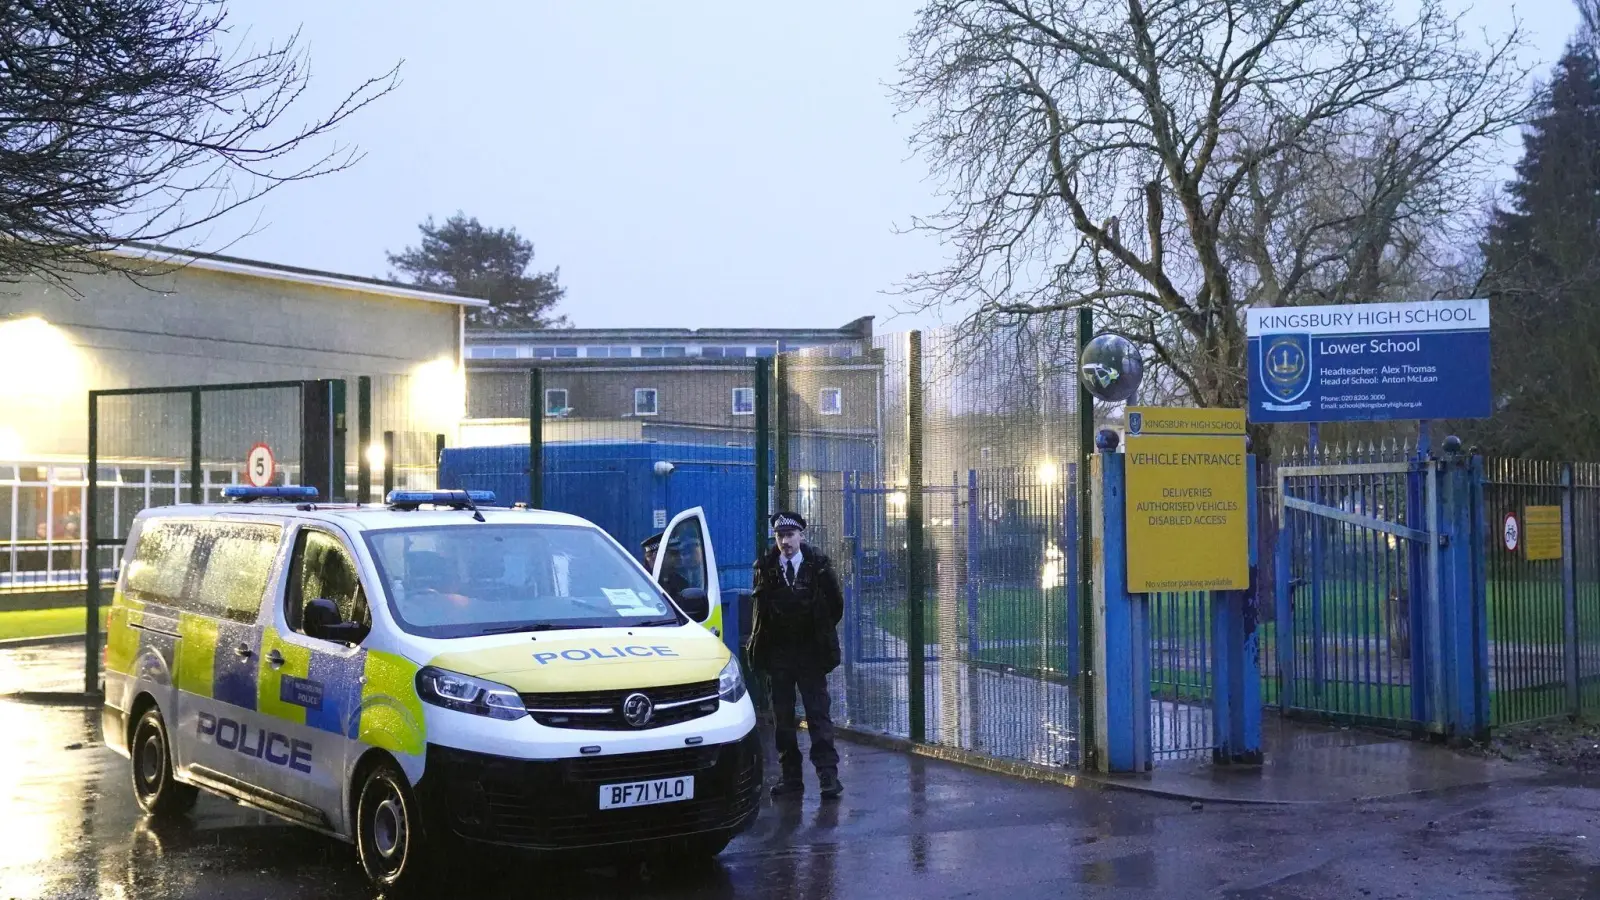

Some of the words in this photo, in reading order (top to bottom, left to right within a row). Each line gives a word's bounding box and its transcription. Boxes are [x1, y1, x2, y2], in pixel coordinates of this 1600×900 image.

[1259, 313, 1353, 329] KINGSBURY
[1358, 311, 1400, 325] HIGH
[1404, 308, 1477, 323] SCHOOL
[1320, 341, 1366, 355] Lower
[1370, 337, 1420, 353] School
[1320, 367, 1378, 376] Headteacher:
[1381, 365, 1400, 374] Alex
[1401, 364, 1437, 374] Thomas
[1342, 377, 1350, 385] of
[1351, 376, 1379, 385] School:
[1382, 375, 1406, 383] Anton
[1407, 374, 1438, 383] McLean
[1145, 420, 1189, 428] KINGSBURY
[1191, 421, 1211, 429] HIGH
[1211, 421, 1243, 430] SCHOOL
[256, 457, 265, 476] 5
[1130, 454, 1179, 465] VEHICLE
[1181, 454, 1242, 466] ENTRANCE
[1162, 488, 1212, 497] DELIVERIES
[1136, 502, 1195, 511] AUTHORISED
[1196, 502, 1238, 511] VEHICLES
[1148, 516, 1192, 525] DISABLED
[1193, 516, 1227, 525] ACCESS
[1145, 580, 1156, 588] No
[1178, 579, 1204, 589] parking
[1204, 576, 1232, 586] available
[532, 646, 679, 665] POLICE
[297, 692, 319, 705] POLICE
[197, 711, 312, 774] POLICE
[611, 783, 649, 804] BF71
[653, 779, 684, 799] YLO
